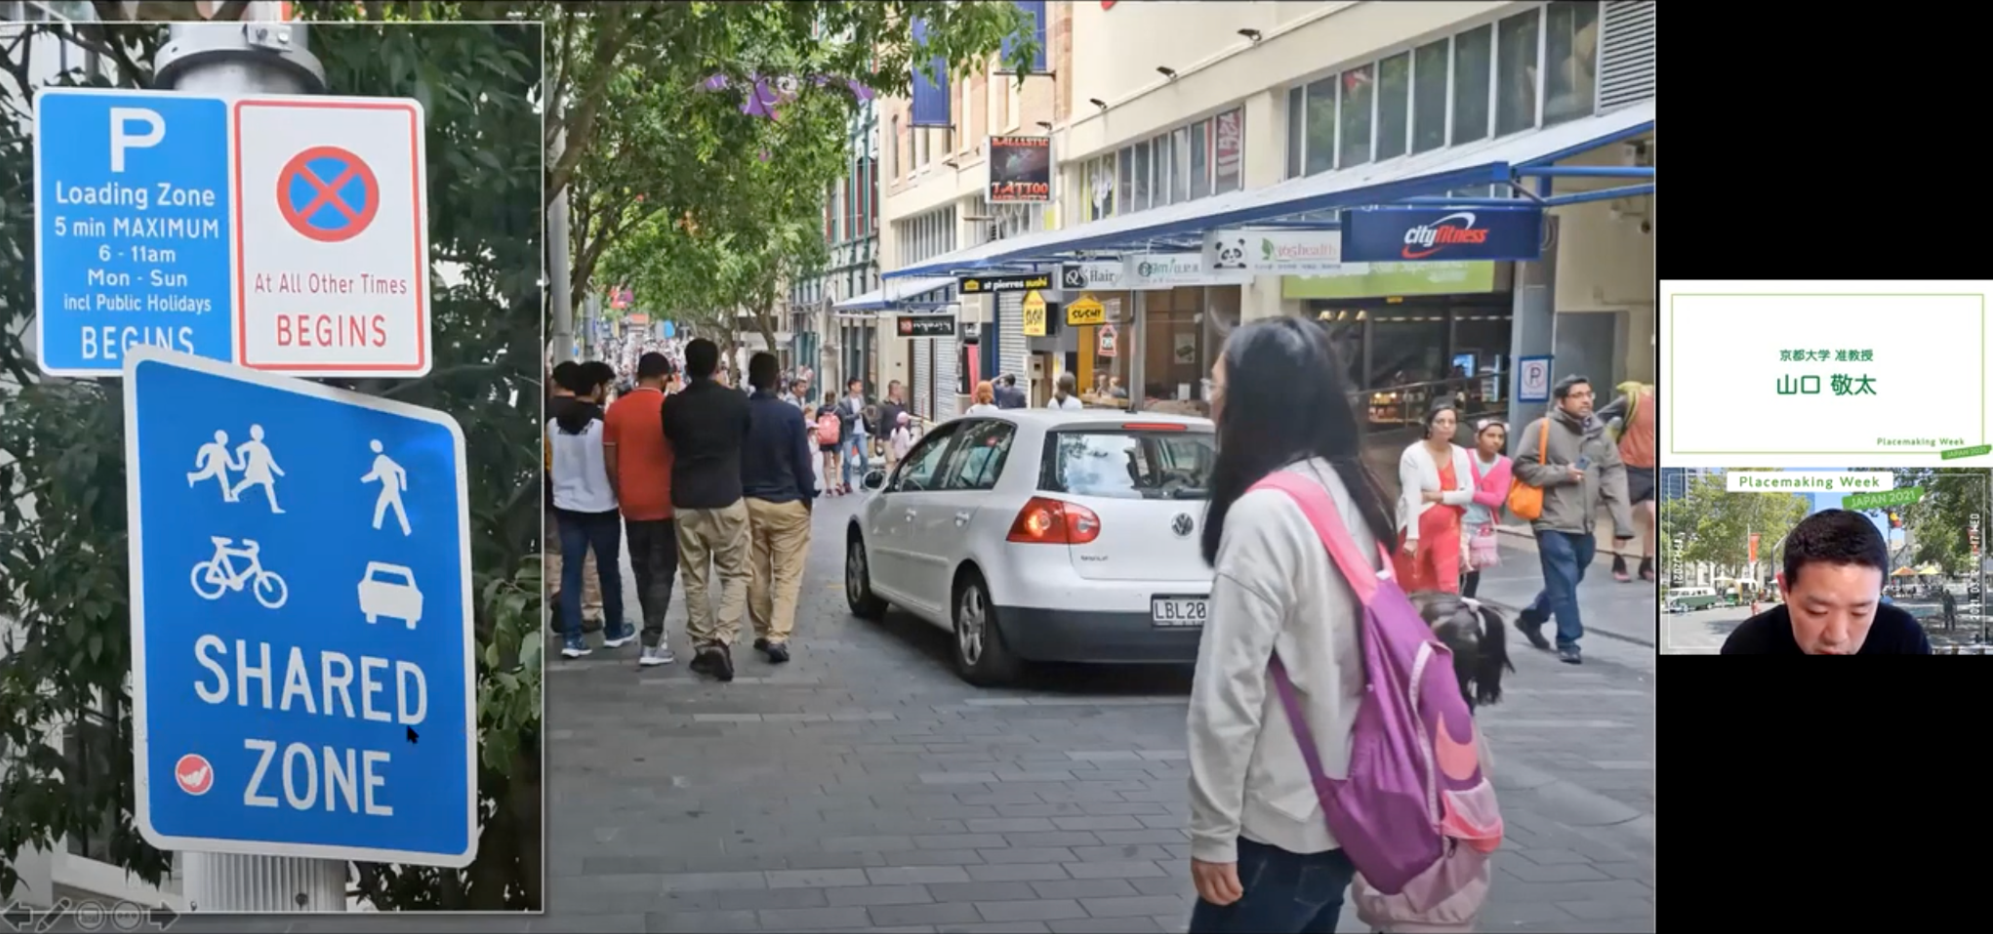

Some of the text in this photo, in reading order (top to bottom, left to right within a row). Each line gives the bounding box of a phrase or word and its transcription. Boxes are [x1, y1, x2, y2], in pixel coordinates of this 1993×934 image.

[110, 107, 166, 173] P
[56, 181, 216, 210] Loading Zone
[991, 181, 1049, 195] TATTOO
[55, 217, 219, 240] 5 min MAXIMUM
[99, 246, 111, 262] 6
[131, 246, 176, 263] 11am
[88, 269, 131, 288] Mon
[150, 269, 188, 288] Sun
[255, 273, 408, 294] At All Other Times
[1026, 277, 1047, 287] sushi
[64, 294, 212, 315] incl Public Holidays
[82, 325, 194, 360] BEGINS
[277, 315, 388, 349] BEGINS
[193, 634, 428, 726] SHARED
[242, 738, 394, 817] ZONE
